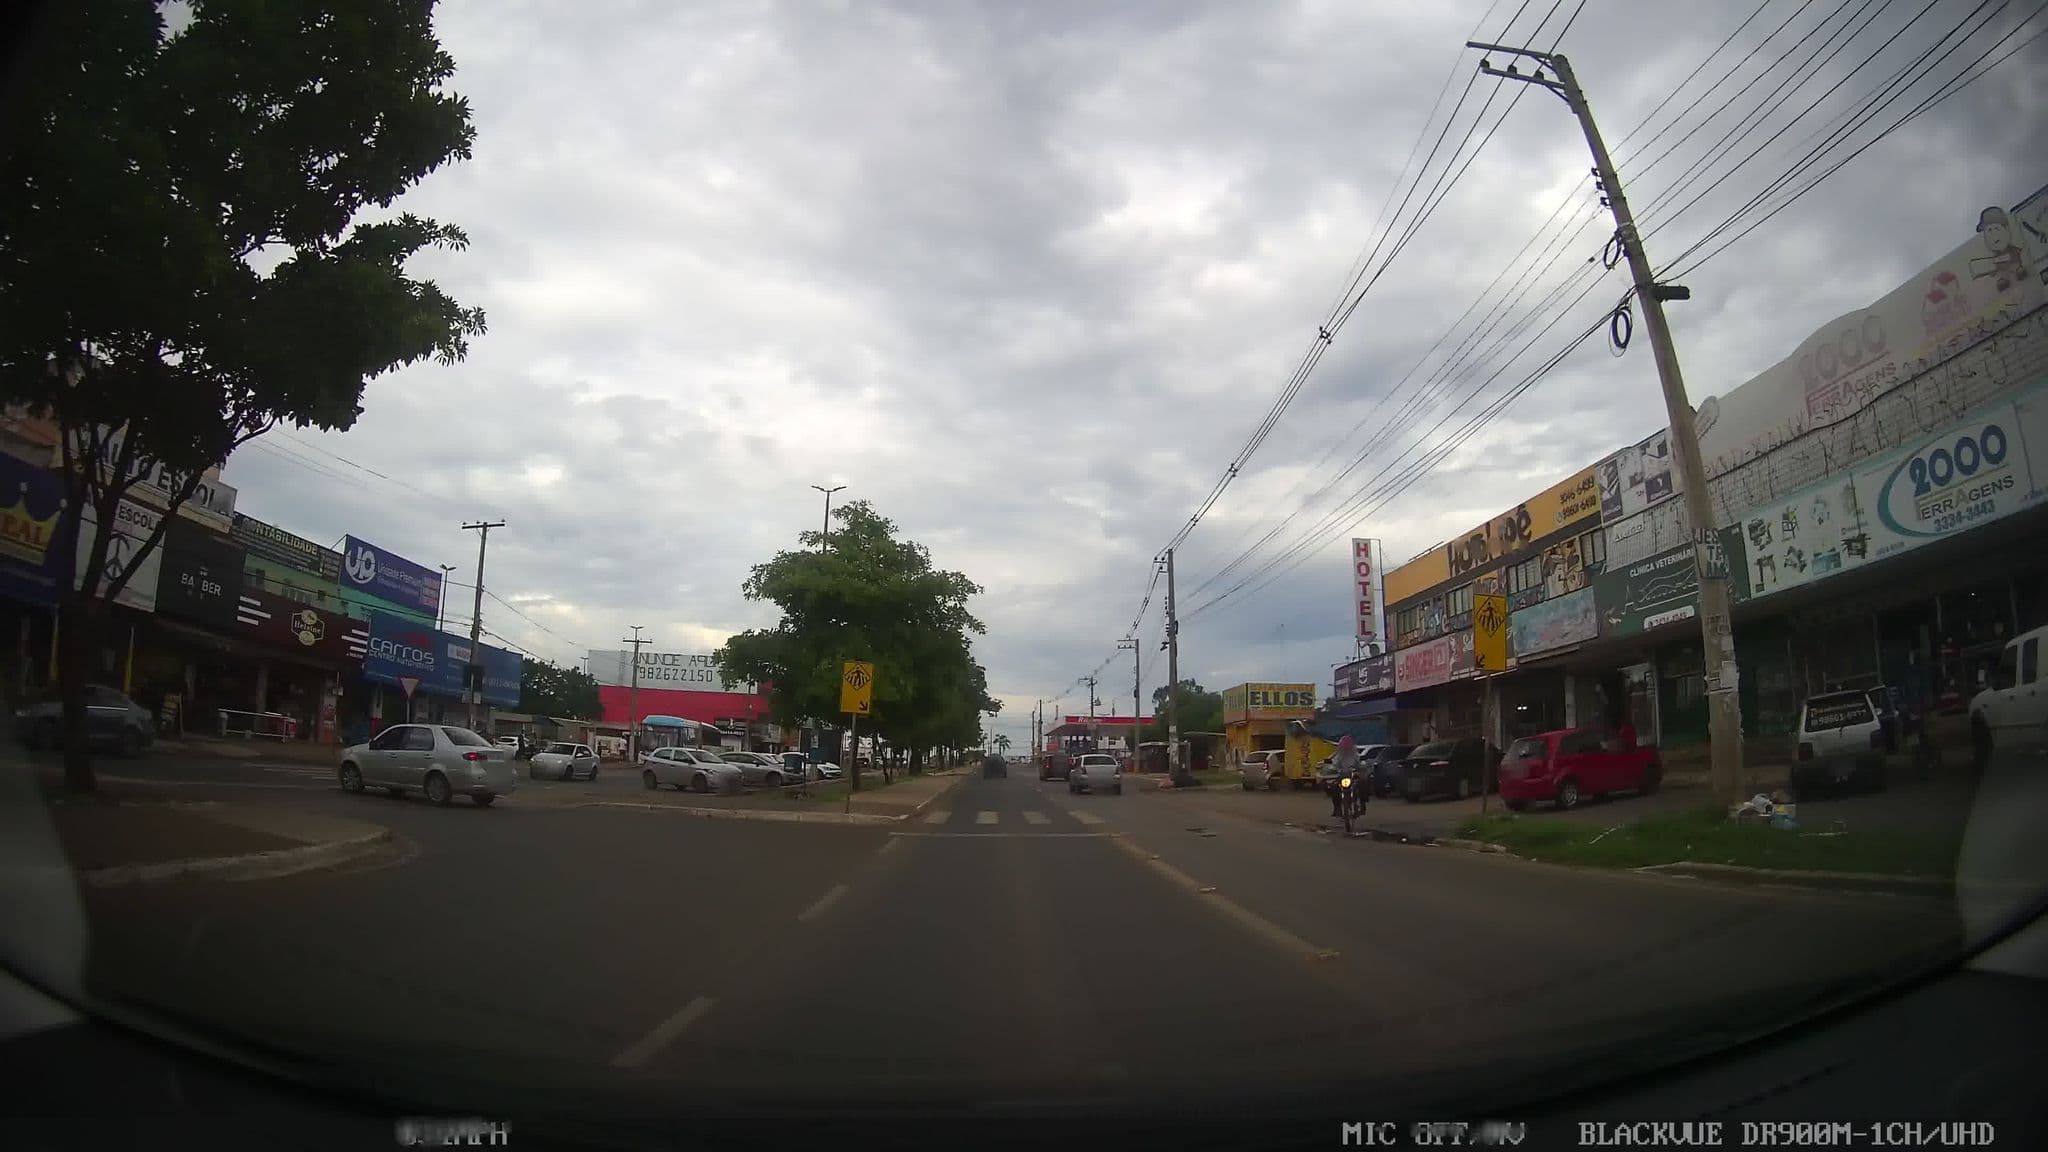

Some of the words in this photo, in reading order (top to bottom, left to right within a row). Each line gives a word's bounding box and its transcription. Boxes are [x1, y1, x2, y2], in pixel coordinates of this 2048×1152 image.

[1909, 424, 2007, 497] 2000
[1355, 542, 1373, 636] HOTEL
[639, 666, 714, 683] 982622150
[1249, 691, 1313, 706] ELLOS
